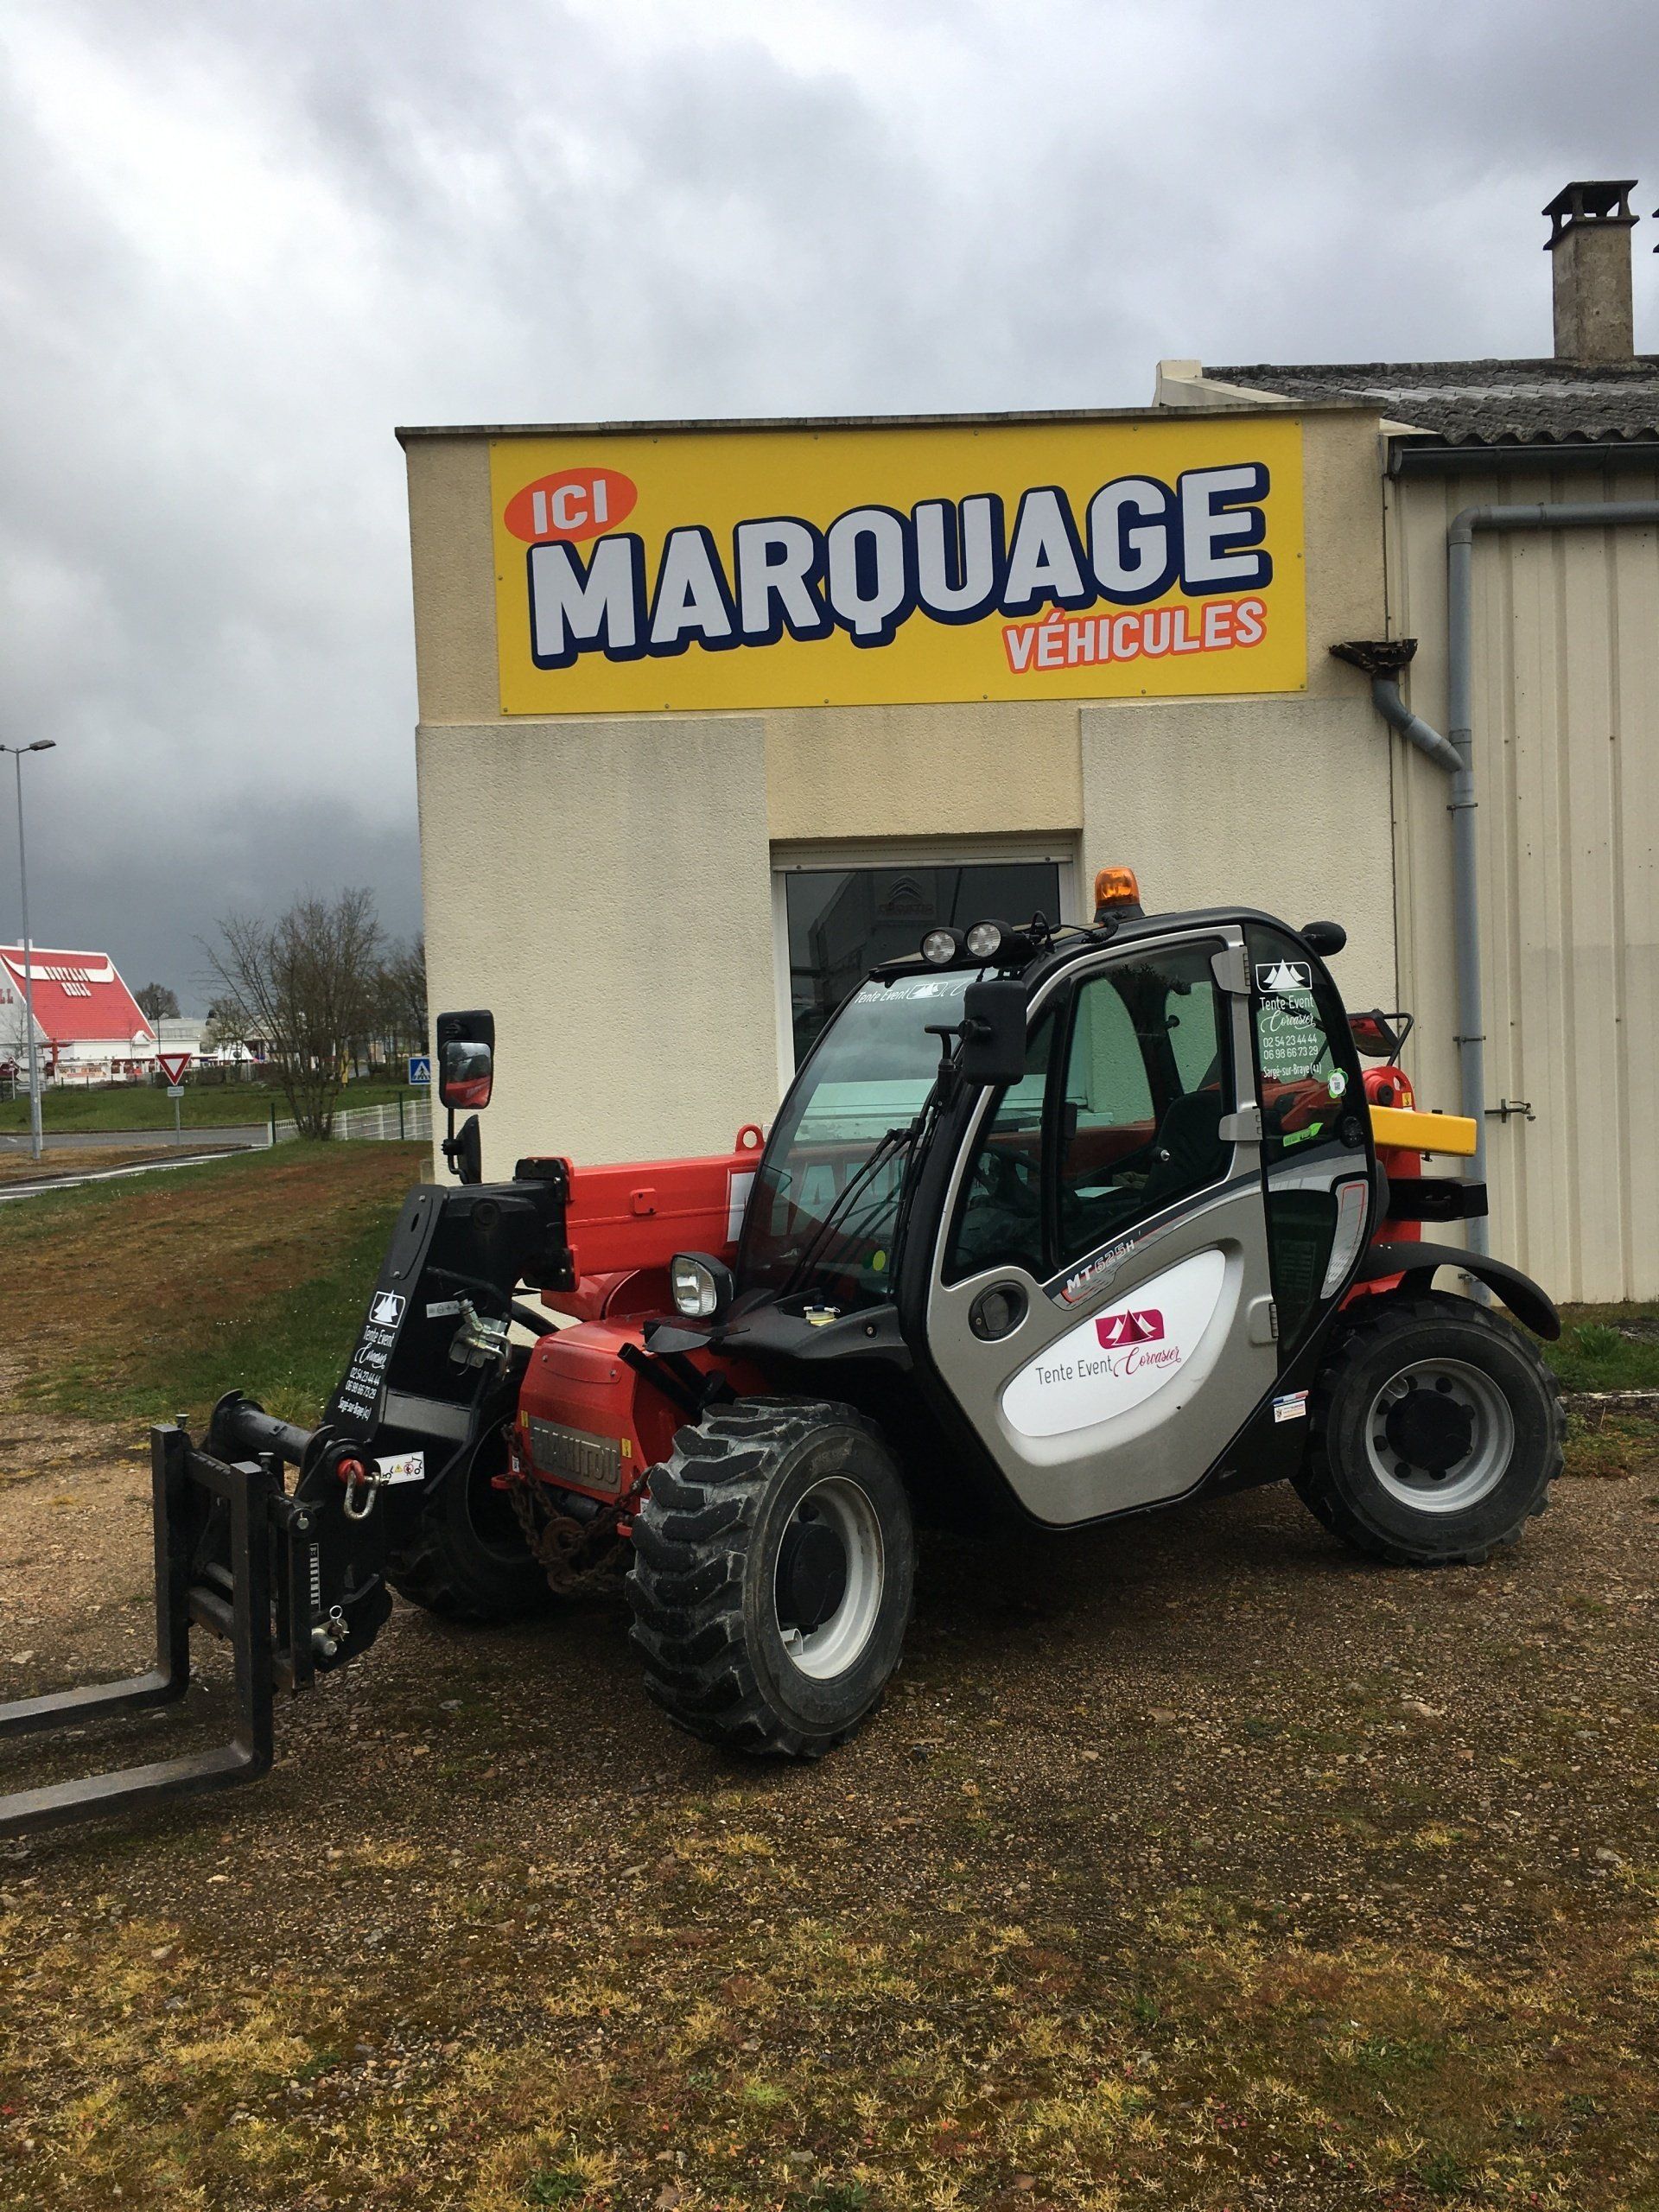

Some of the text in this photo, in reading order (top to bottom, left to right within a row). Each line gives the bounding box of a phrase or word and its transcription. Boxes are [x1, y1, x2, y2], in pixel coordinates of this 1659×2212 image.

[532, 479, 609, 535] ICI
[526, 461, 1272, 670] MARQUAGE
[1006, 600, 1268, 672] VÉHICULES
[855, 988, 910, 1004] Tente Event
[1259, 994, 1313, 1011] Tente Event
[1263, 1033, 1318, 1048] 02 54 23 44 44
[1263, 1049, 1274, 1059] 06
[1287, 1047, 1297, 1058] 66
[1298, 1046, 1307, 1057] 73
[1308, 1045, 1319, 1056] 29
[1066, 1264, 1092, 1294] MT
[1035, 1363, 1073, 1385] Tente
[1077, 1355, 1113, 1379] Event
